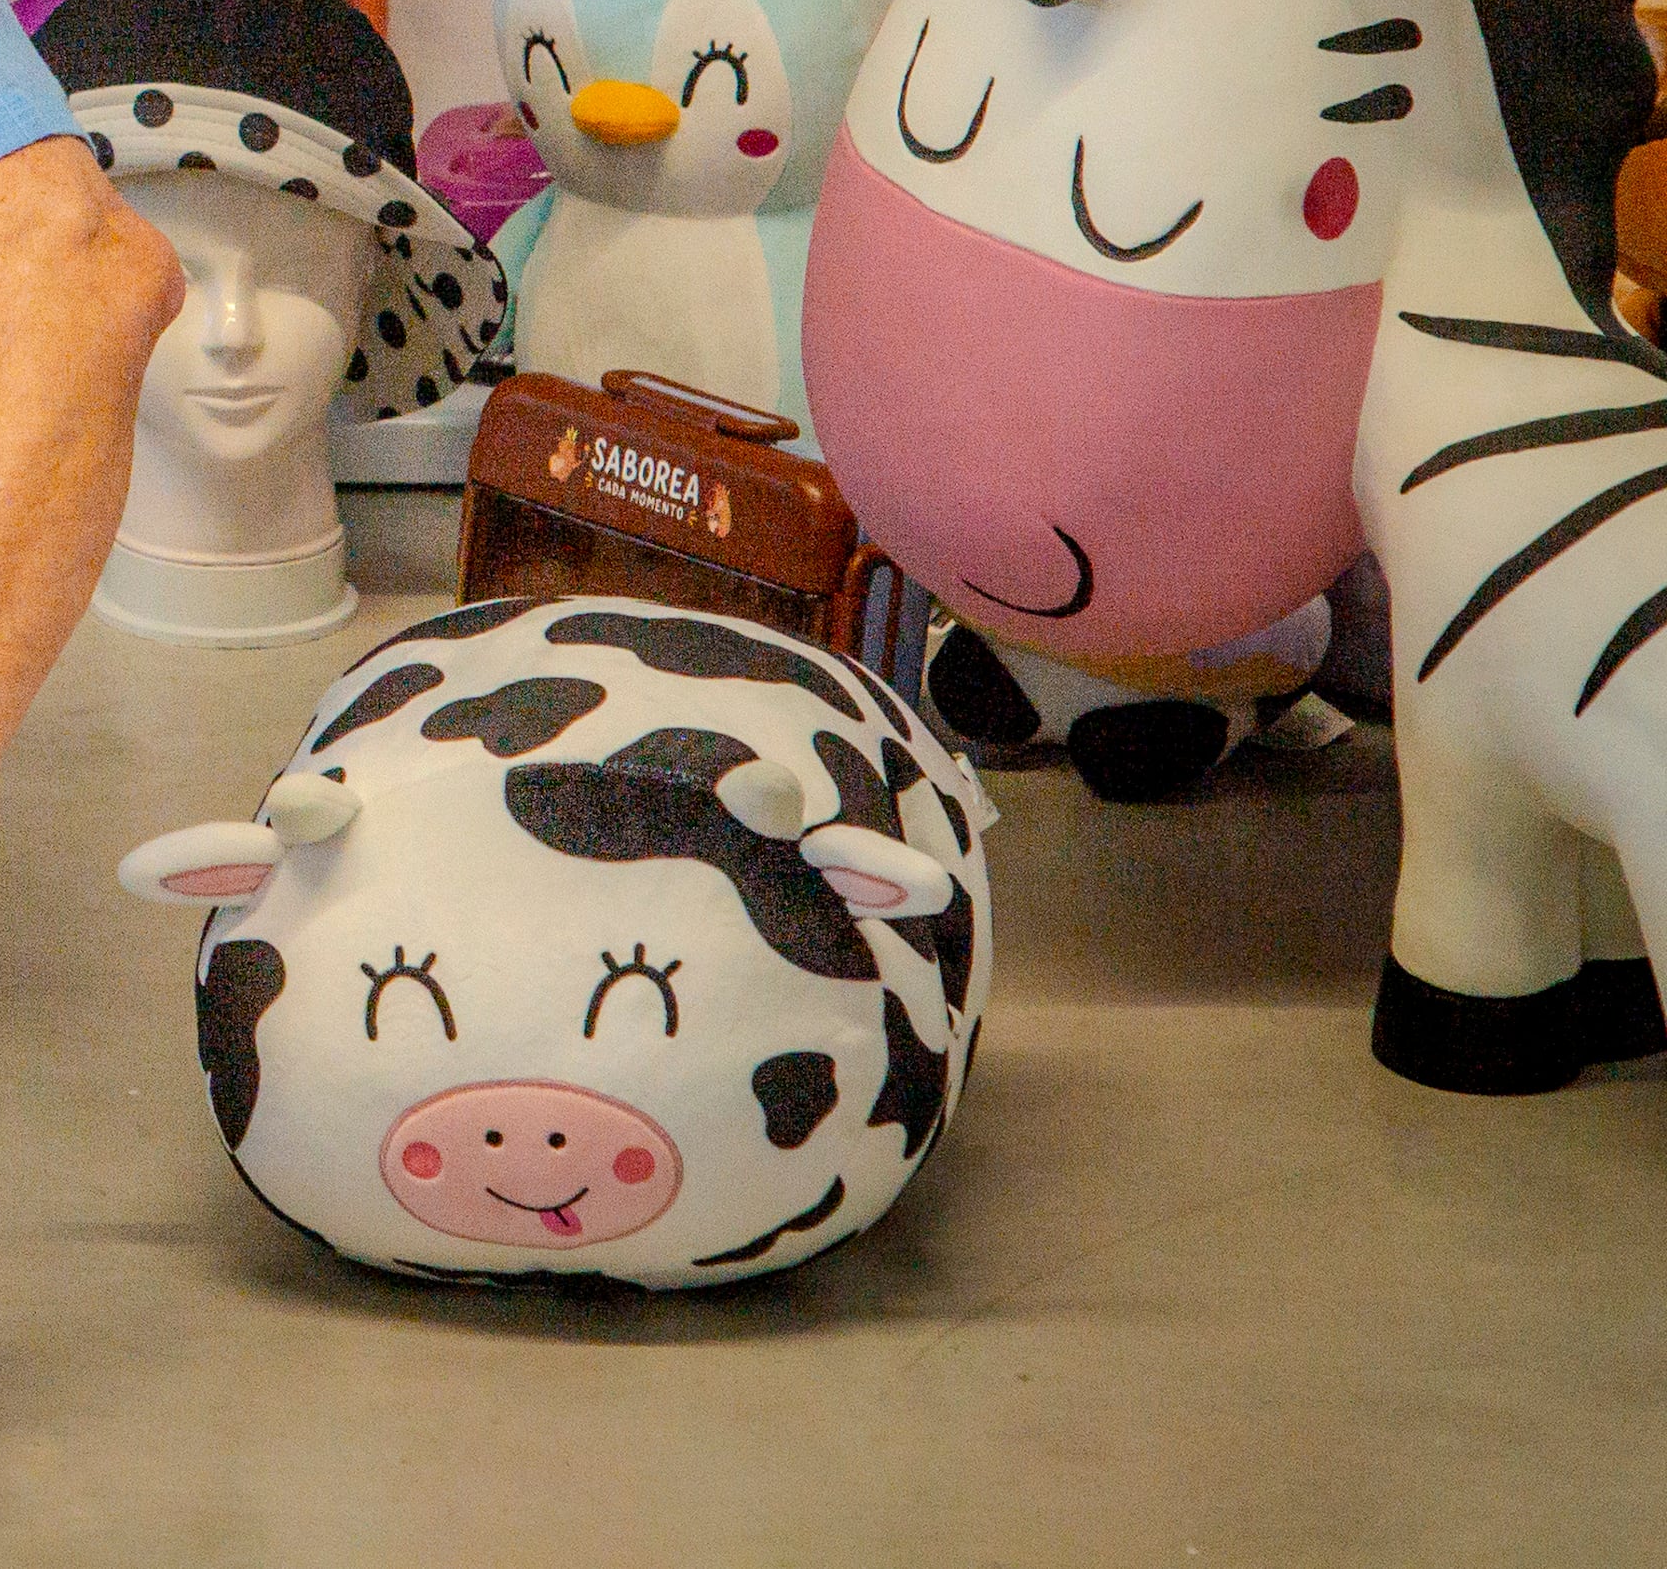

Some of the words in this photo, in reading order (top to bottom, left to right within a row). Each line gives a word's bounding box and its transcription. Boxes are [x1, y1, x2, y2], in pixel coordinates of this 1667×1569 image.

[591, 437, 700, 507] SABOREA
[598, 477, 626, 500] CADA
[630, 489, 684, 521] MOMENTO
